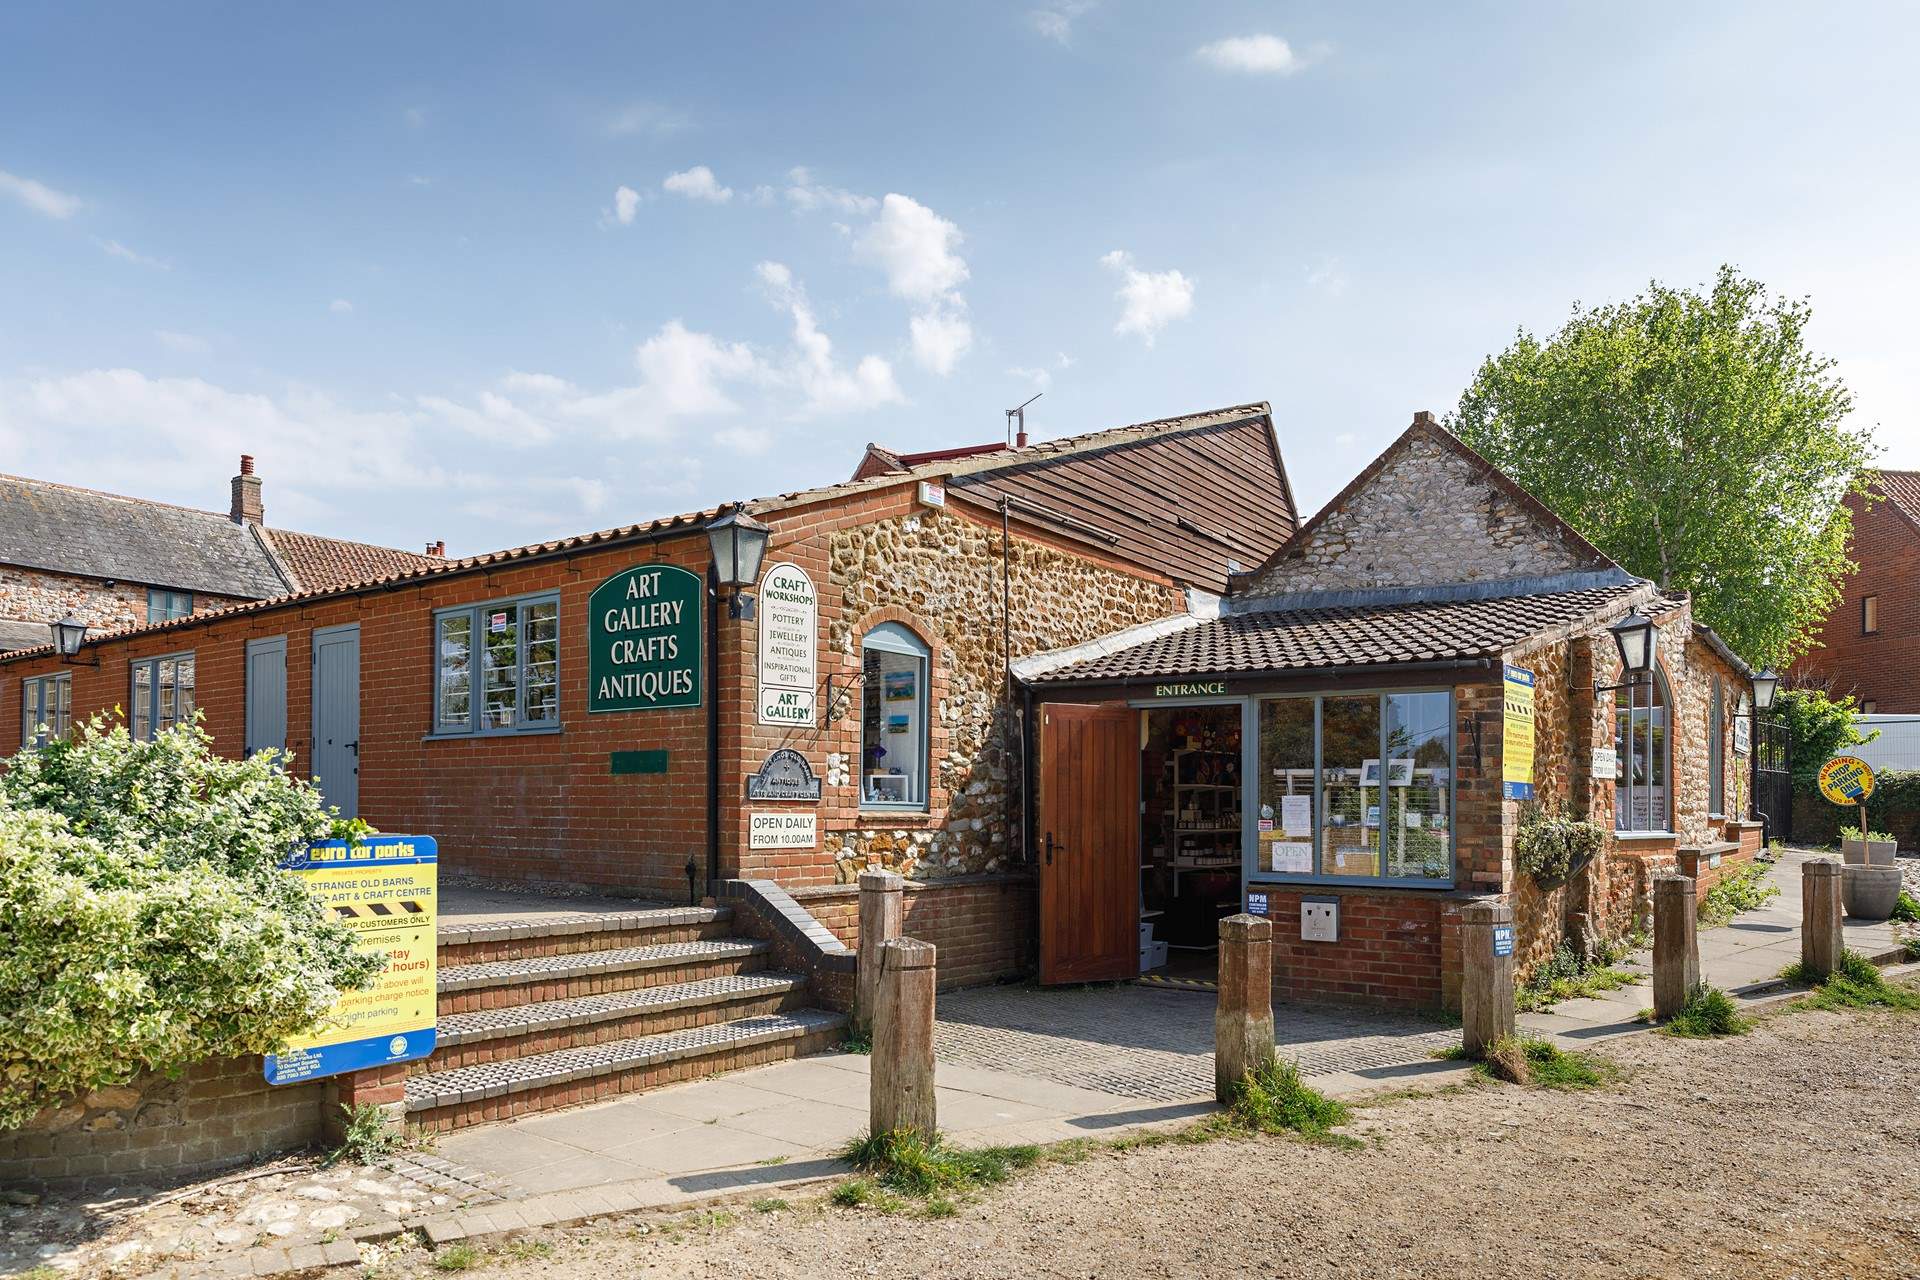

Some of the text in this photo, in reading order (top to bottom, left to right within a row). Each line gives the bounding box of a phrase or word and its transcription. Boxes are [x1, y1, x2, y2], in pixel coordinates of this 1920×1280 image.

[626, 572, 661, 600] ART
[773, 576, 806, 593] CRAFT
[765, 589, 813, 606] WORKSHOPS
[604, 600, 684, 633] GALLERY
[772, 613, 804, 626] POTTERY
[769, 630, 807, 643] JEWELLERY
[611, 635, 678, 665] CRAFTS
[770, 646, 807, 658] ANTIQUES
[764, 662, 811, 674] INSPIRATIONAL
[779, 673, 797, 683] GIFTS
[598, 669, 693, 702] ANTIQUES
[1156, 682, 1225, 696] ENTRANCE
[777, 693, 799, 706] ART
[766, 705, 810, 720] GALLERY
[1820, 757, 1855, 780] WARNING
[1829, 764, 1850, 780] SHOP
[1828, 767, 1863, 791] PARKING
[1840, 778, 1861, 794] ONLY
[754, 817, 813, 829] OPEN DAILY
[753, 834, 813, 844] FROM 10.00AM
[310, 842, 415, 861] euro car parks
[1275, 846, 1307, 857] OPEN
[311, 877, 414, 891] STRANGE OLD BARNS
[332, 892, 350, 902] ART
[354, 892, 361, 900] &
[363, 889, 393, 899] CRAFT
[396, 887, 432, 898] CENTRE
[1249, 894, 1267, 903] NPM
[360, 917, 408, 929] CUSTOMERS
[410, 915, 430, 924] ONLY
[1495, 929, 1510, 940] NPM
[393, 958, 430, 972] hours)
[384, 979, 409, 989] above
[411, 976, 424, 984] will
[341, 996, 373, 1008] parking
[375, 992, 403, 1002] charge
[405, 987, 430, 998] notice
[367, 1007, 399, 1020] parking
